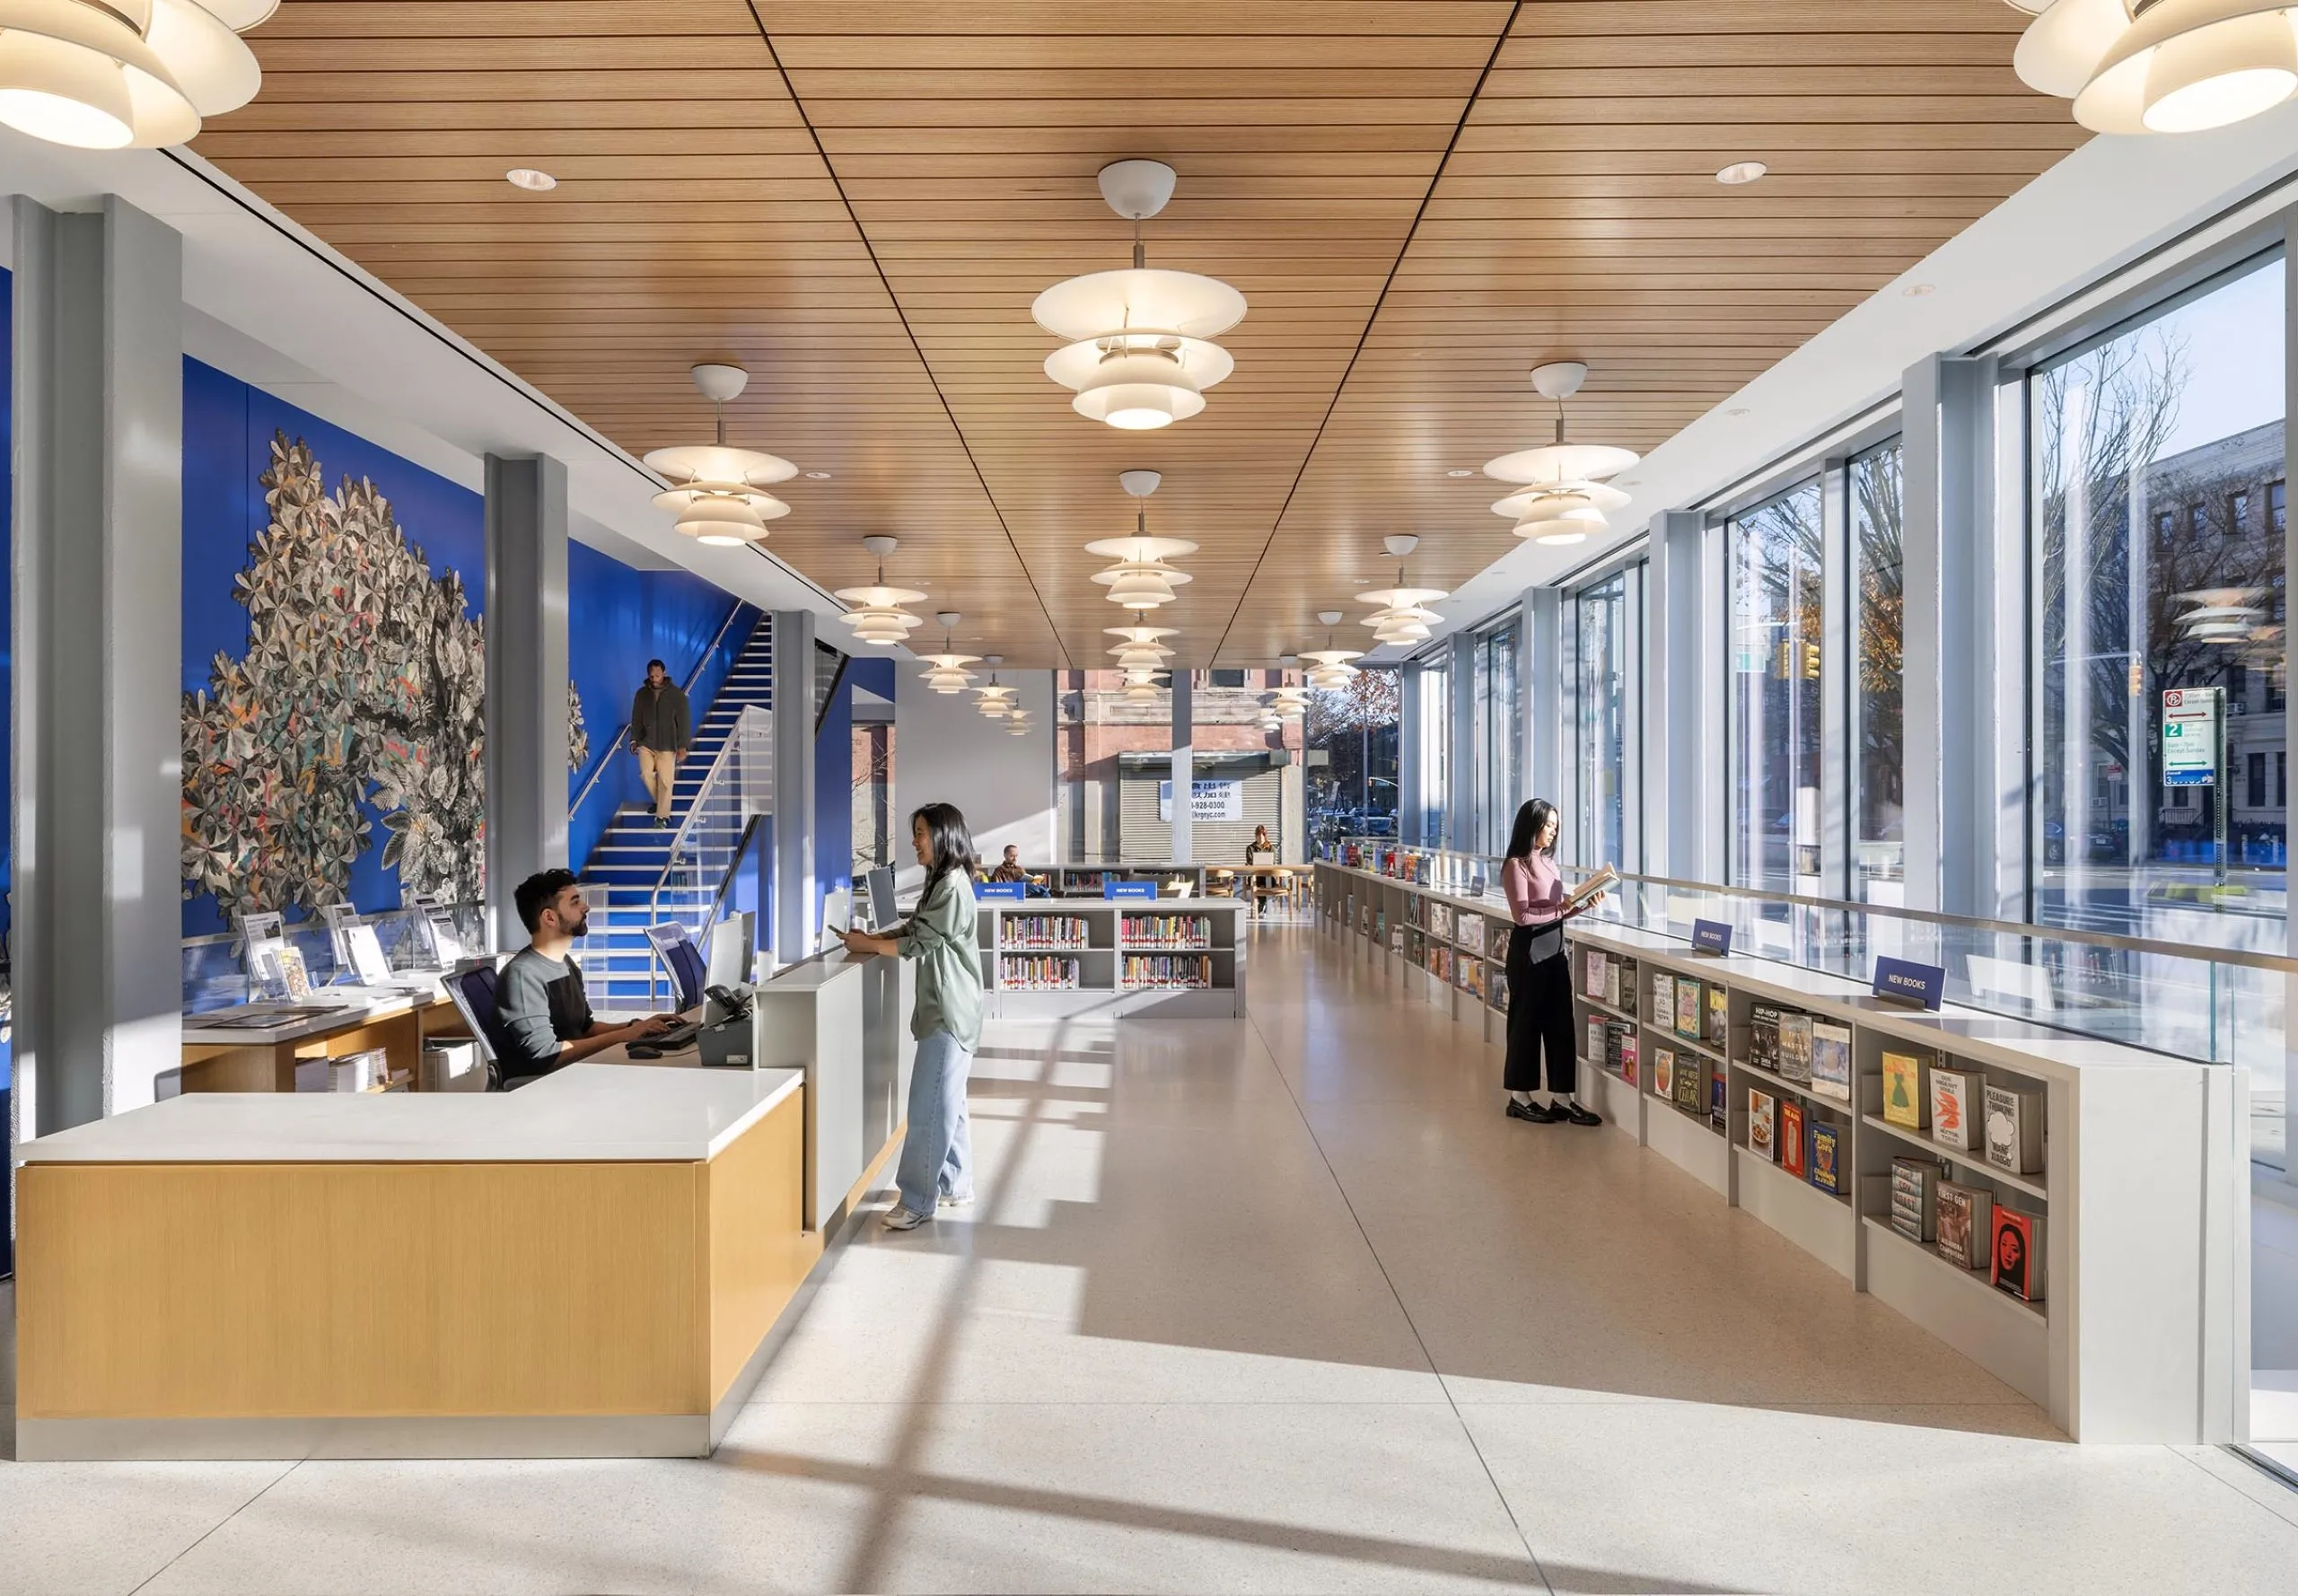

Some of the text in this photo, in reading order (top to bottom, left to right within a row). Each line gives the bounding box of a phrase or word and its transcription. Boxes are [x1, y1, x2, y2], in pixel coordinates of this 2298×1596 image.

[2169, 723, 2179, 736] 2
[1709, 933, 1722, 942] BOOKS
[1888, 973, 1926, 990] NEW BOOKS
[1782, 1041, 1809, 1050] MASTER
